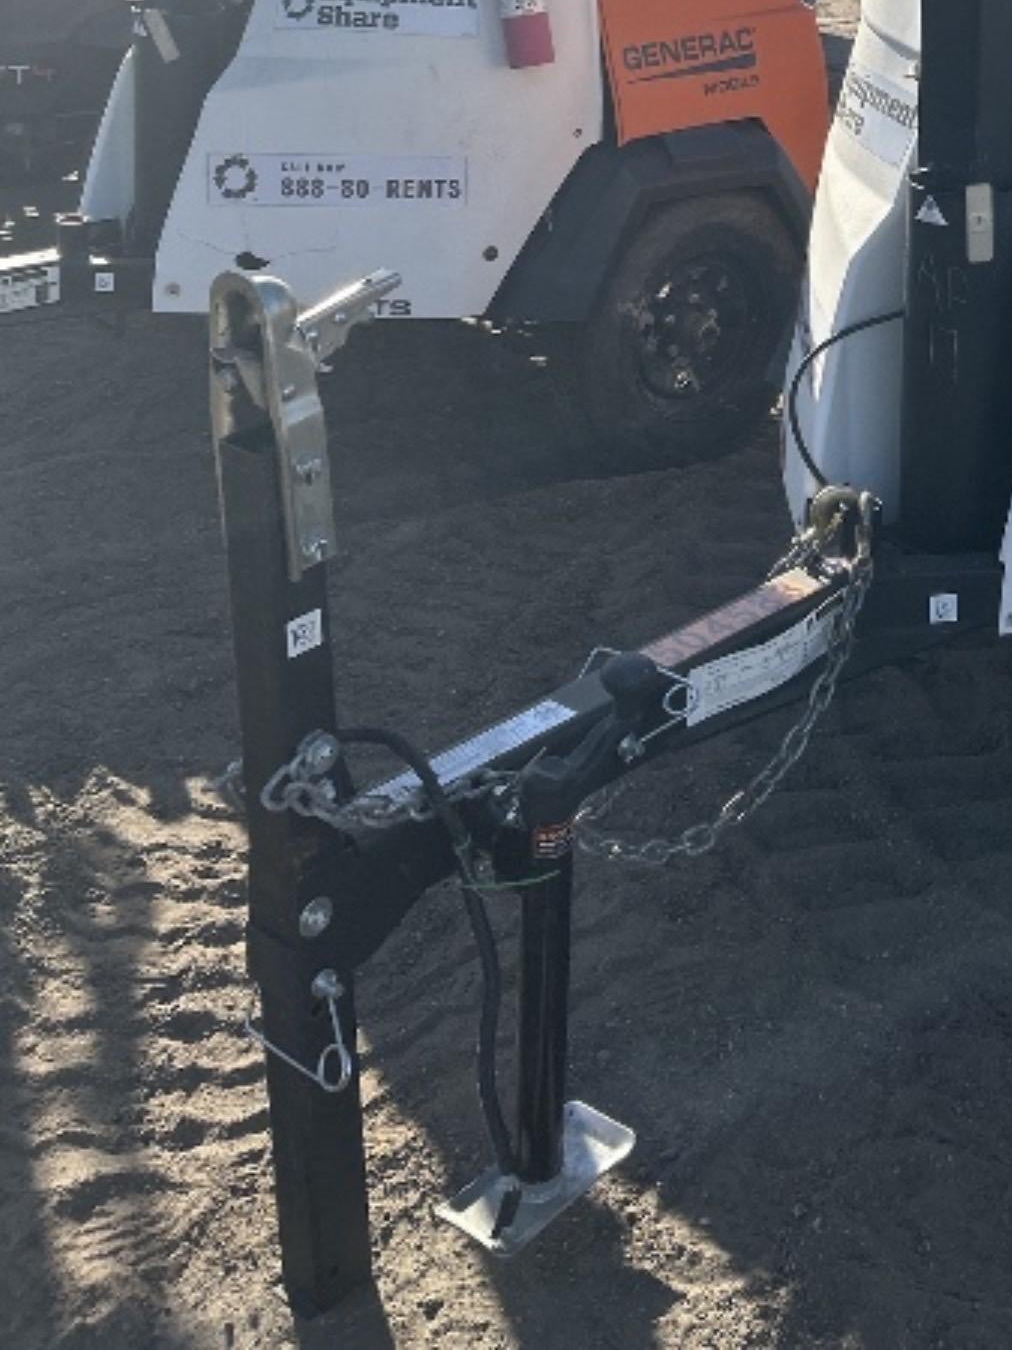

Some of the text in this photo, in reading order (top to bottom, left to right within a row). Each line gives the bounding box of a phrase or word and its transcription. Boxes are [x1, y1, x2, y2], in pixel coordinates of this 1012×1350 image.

[316, 5, 399, 31] Share
[622, 27, 755, 70] GENERAC
[280, 176, 462, 200] 888-80-RENTS
